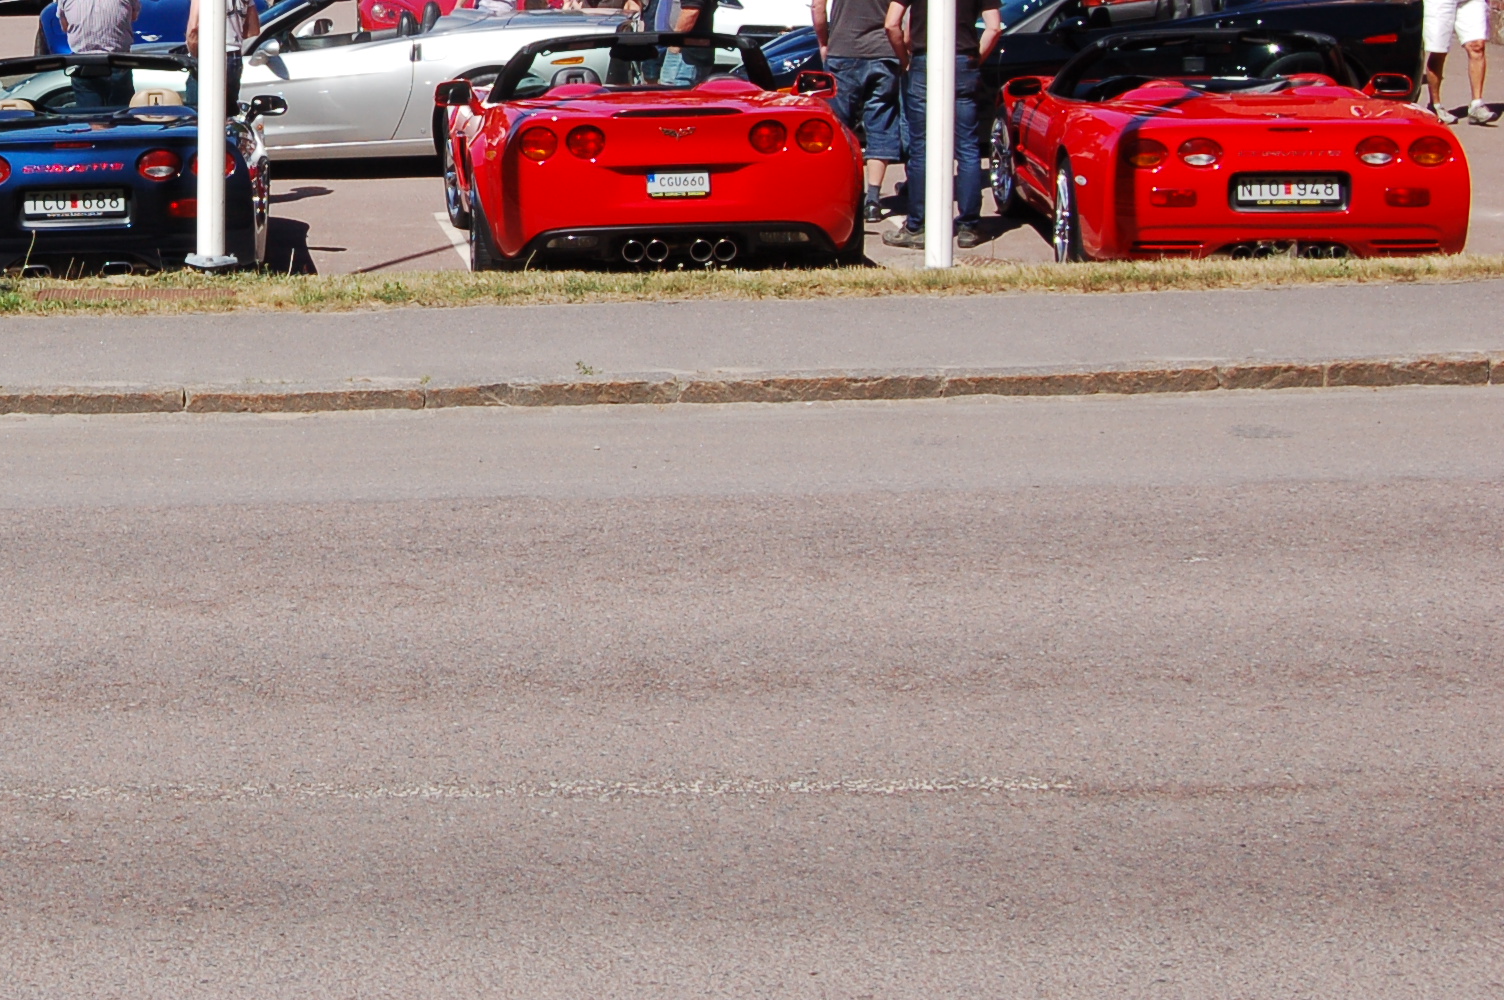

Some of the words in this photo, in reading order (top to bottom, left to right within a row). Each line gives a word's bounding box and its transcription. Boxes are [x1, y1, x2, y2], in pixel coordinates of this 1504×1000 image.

[1241, 179, 1280, 197] NTO
[1296, 179, 1335, 197] 948
[28, 193, 66, 211] TCU
[82, 192, 120, 210] 688
